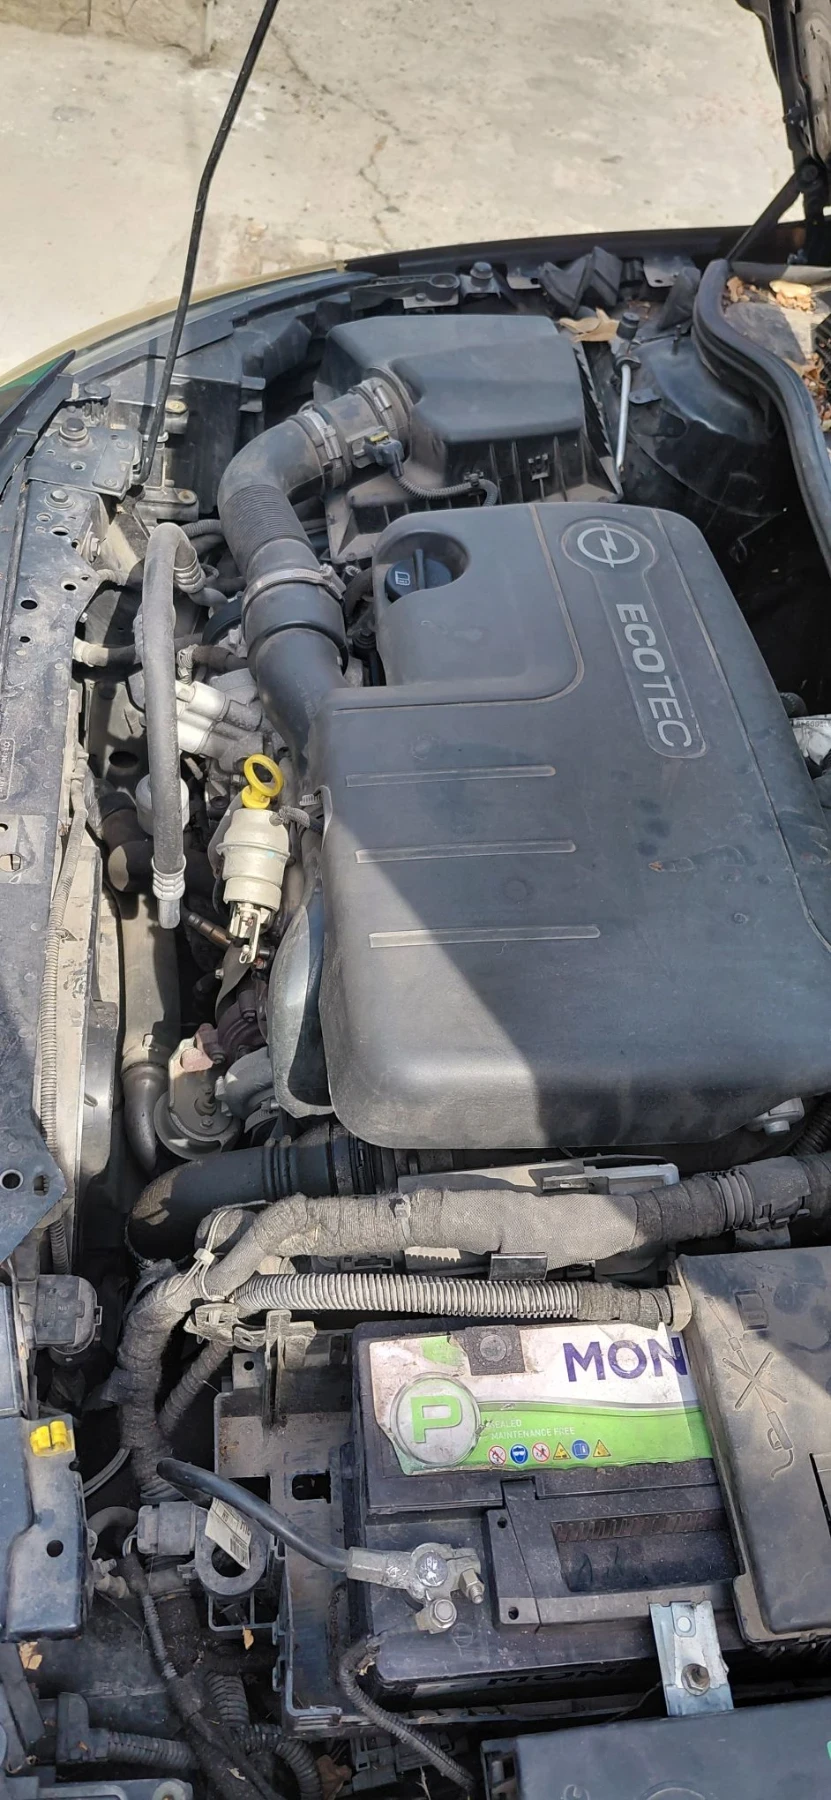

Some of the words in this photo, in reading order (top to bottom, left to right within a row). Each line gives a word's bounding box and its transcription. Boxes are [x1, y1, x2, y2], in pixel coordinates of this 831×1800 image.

[616, 604, 692, 748] ECOTEC
[563, 1337, 688, 1382] MON
[411, 1395, 463, 1443] P
[491, 1428, 551, 1440] MAINTENANCE
[553, 1426, 576, 1436] FREE
